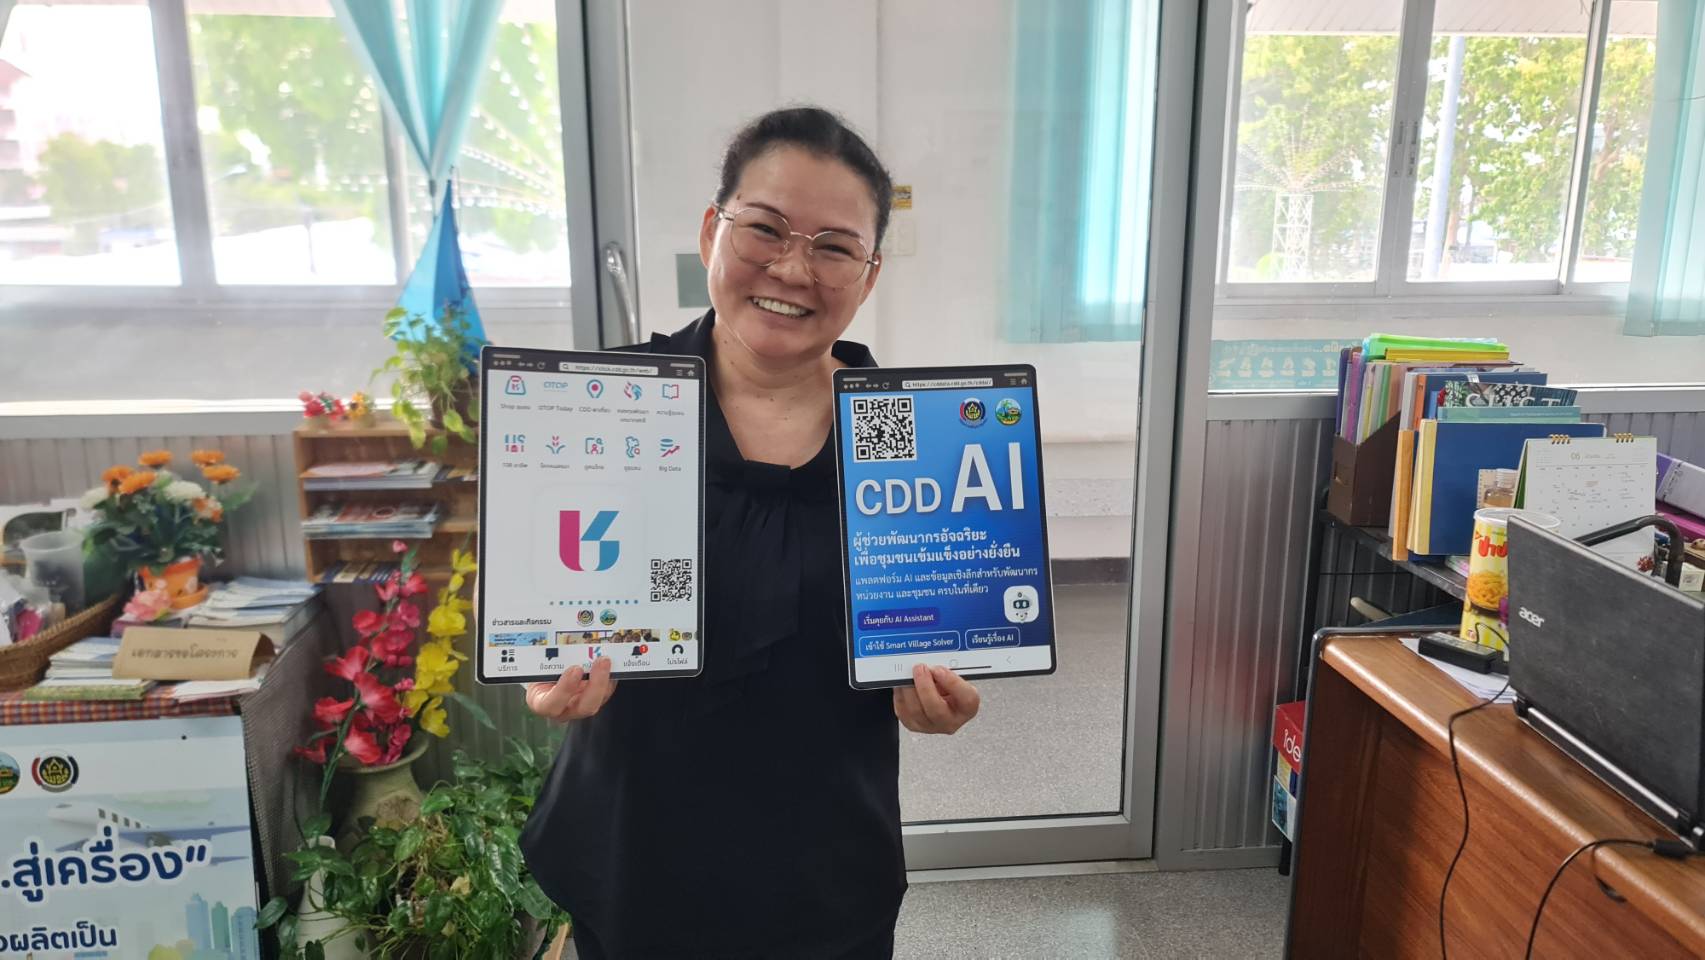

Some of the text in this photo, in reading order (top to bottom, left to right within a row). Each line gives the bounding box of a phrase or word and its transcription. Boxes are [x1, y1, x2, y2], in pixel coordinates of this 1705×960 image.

[855, 442, 1025, 516] CDD AI
[853, 527, 988, 552] ผู้ช่วยพัฒนากรอัจฉริยะ
[854, 540, 1021, 569] เพื่อชุมชนเข้มแข็งอย่างยั่งยืน
[855, 571, 902, 586] แพลตฟอร์ม
[904, 573, 913, 583] AI
[855, 589, 894, 601] หน่วยงาน
[896, 587, 935, 600] และชุมชน
[895, 615, 902, 623] AI
[904, 614, 934, 623] Assistant
[1518, 606, 1545, 628] acer
[886, 642, 907, 650] Smart
[908, 639, 932, 649] Village
[933, 637, 954, 647] Solver
[1006, 633, 1014, 642] AI
[0, 920, 117, 952] ผลิตเป็น
